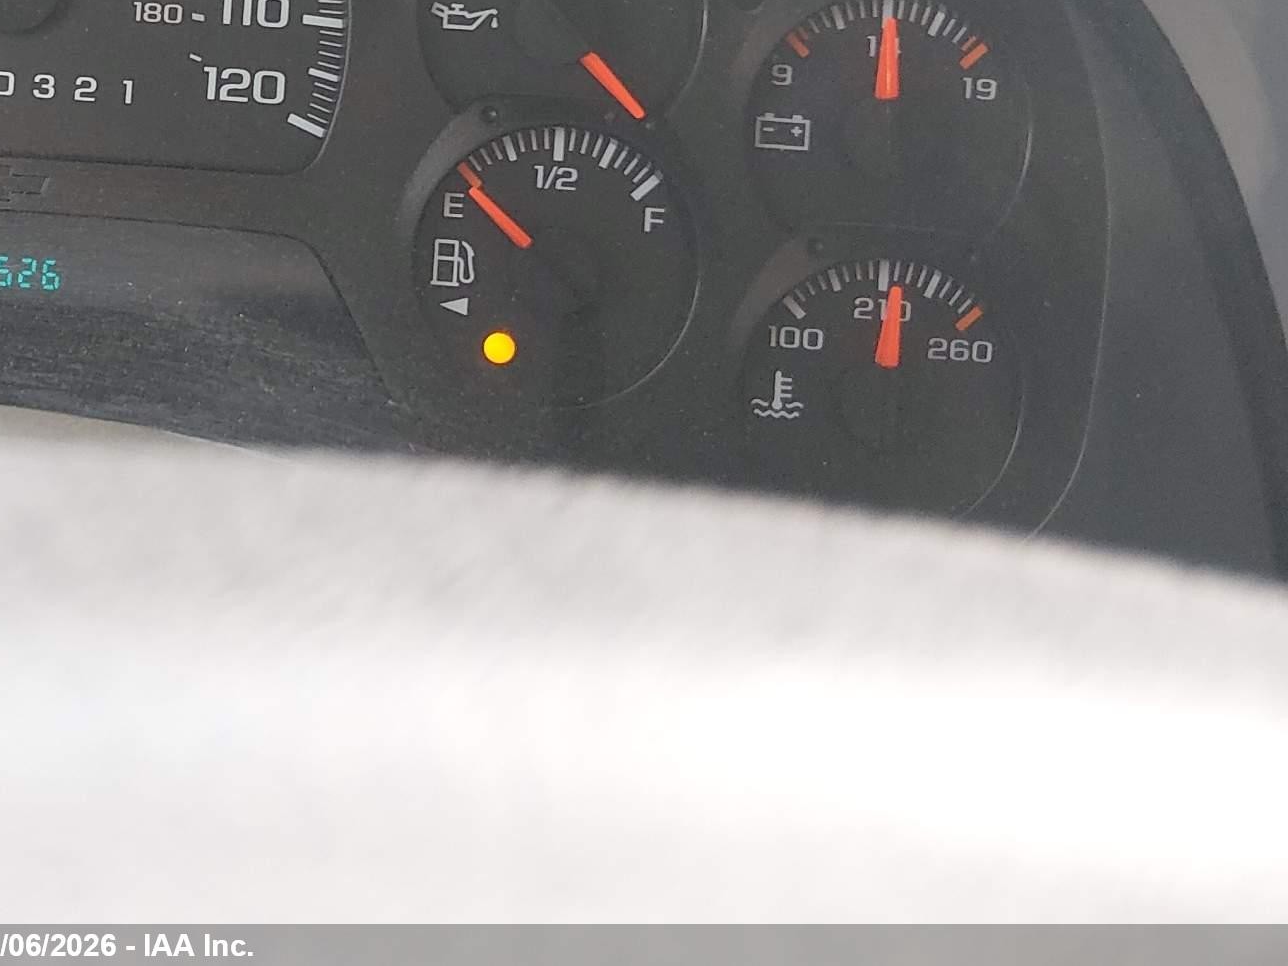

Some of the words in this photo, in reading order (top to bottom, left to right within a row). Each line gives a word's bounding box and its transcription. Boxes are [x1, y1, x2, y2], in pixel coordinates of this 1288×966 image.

[134, 2, 182, 23] 180
[204, 67, 285, 103] 120
[772, 65, 792, 85] 9
[33, 75, 54, 98] 3
[75, 77, 96, 101] 2
[123, 80, 132, 103] 1
[964, 78, 997, 99] 19
[534, 166, 577, 190] 1/2
[444, 193, 464, 217] E
[644, 208, 665, 232] F
[770, 326, 823, 349] 100
[928, 338, 992, 362] 260
